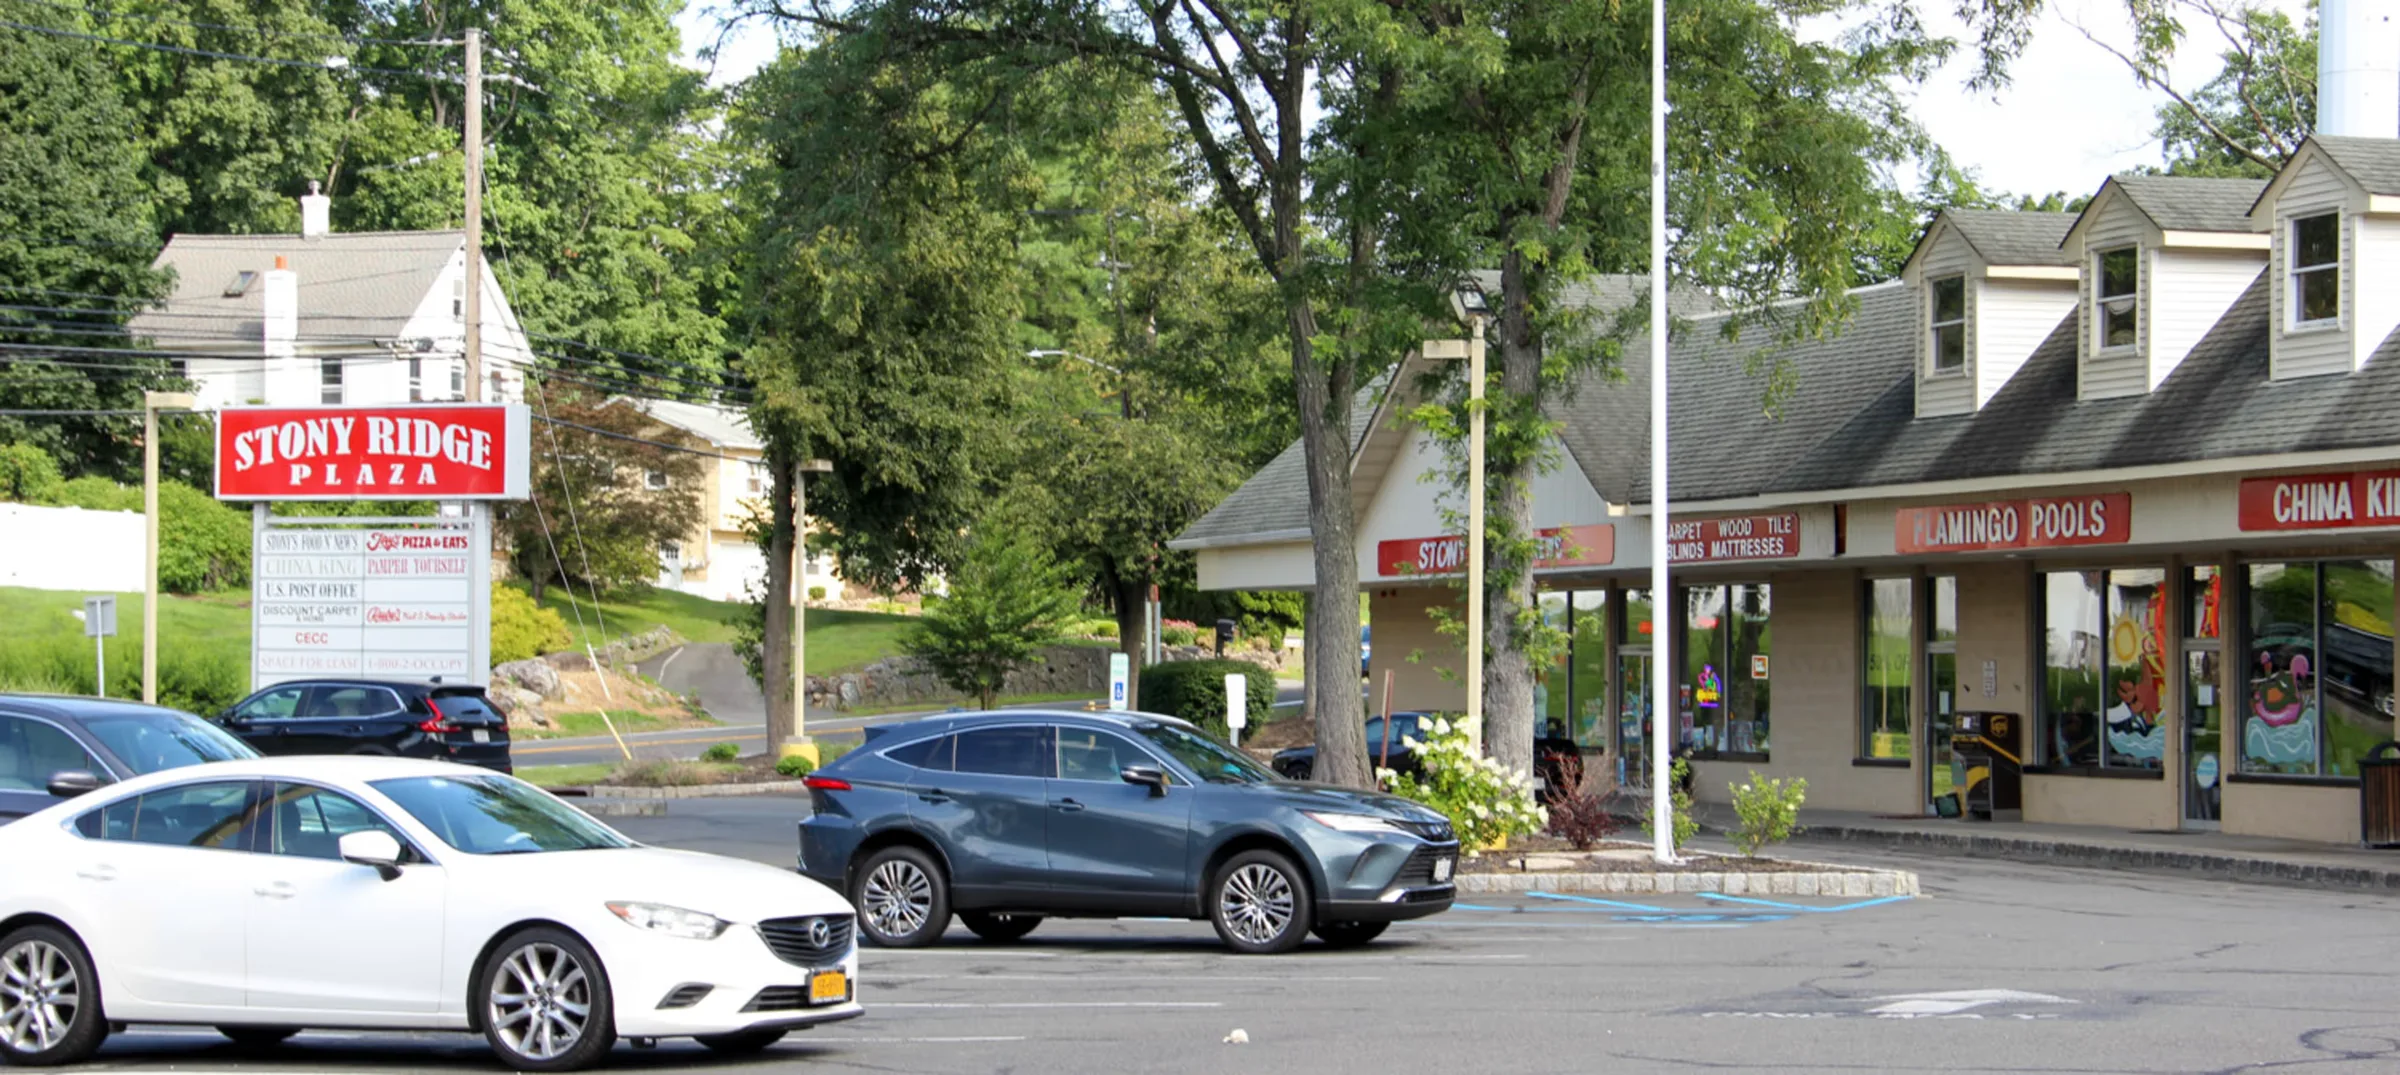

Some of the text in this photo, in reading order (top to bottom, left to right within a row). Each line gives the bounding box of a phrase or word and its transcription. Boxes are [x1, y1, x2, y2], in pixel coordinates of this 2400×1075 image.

[234, 416, 492, 472] STONY RIDGE
[290, 463, 437, 486] PLAZA
[2273, 480, 2354, 523] CHINA
[1669, 515, 1792, 540] ARPET WOOD TILE
[1913, 499, 2106, 546] FLAMINGO POOLS
[334, 534, 358, 550] NEWS
[402, 536, 432, 549] PIZZA
[442, 536, 468, 549] EATS
[1711, 537, 1784, 558] MATTRESSES
[266, 559, 357, 574] CHINA KING
[367, 558, 467, 574] PAMPER YOURSELF
[289, 583, 317, 597] POST
[319, 583, 357, 598] OFFICE
[263, 605, 314, 616] DISCOUNT
[318, 606, 358, 616] CARPET
[295, 632, 328, 644] CECC
[261, 656, 359, 669] SPACE FOR LEASE
